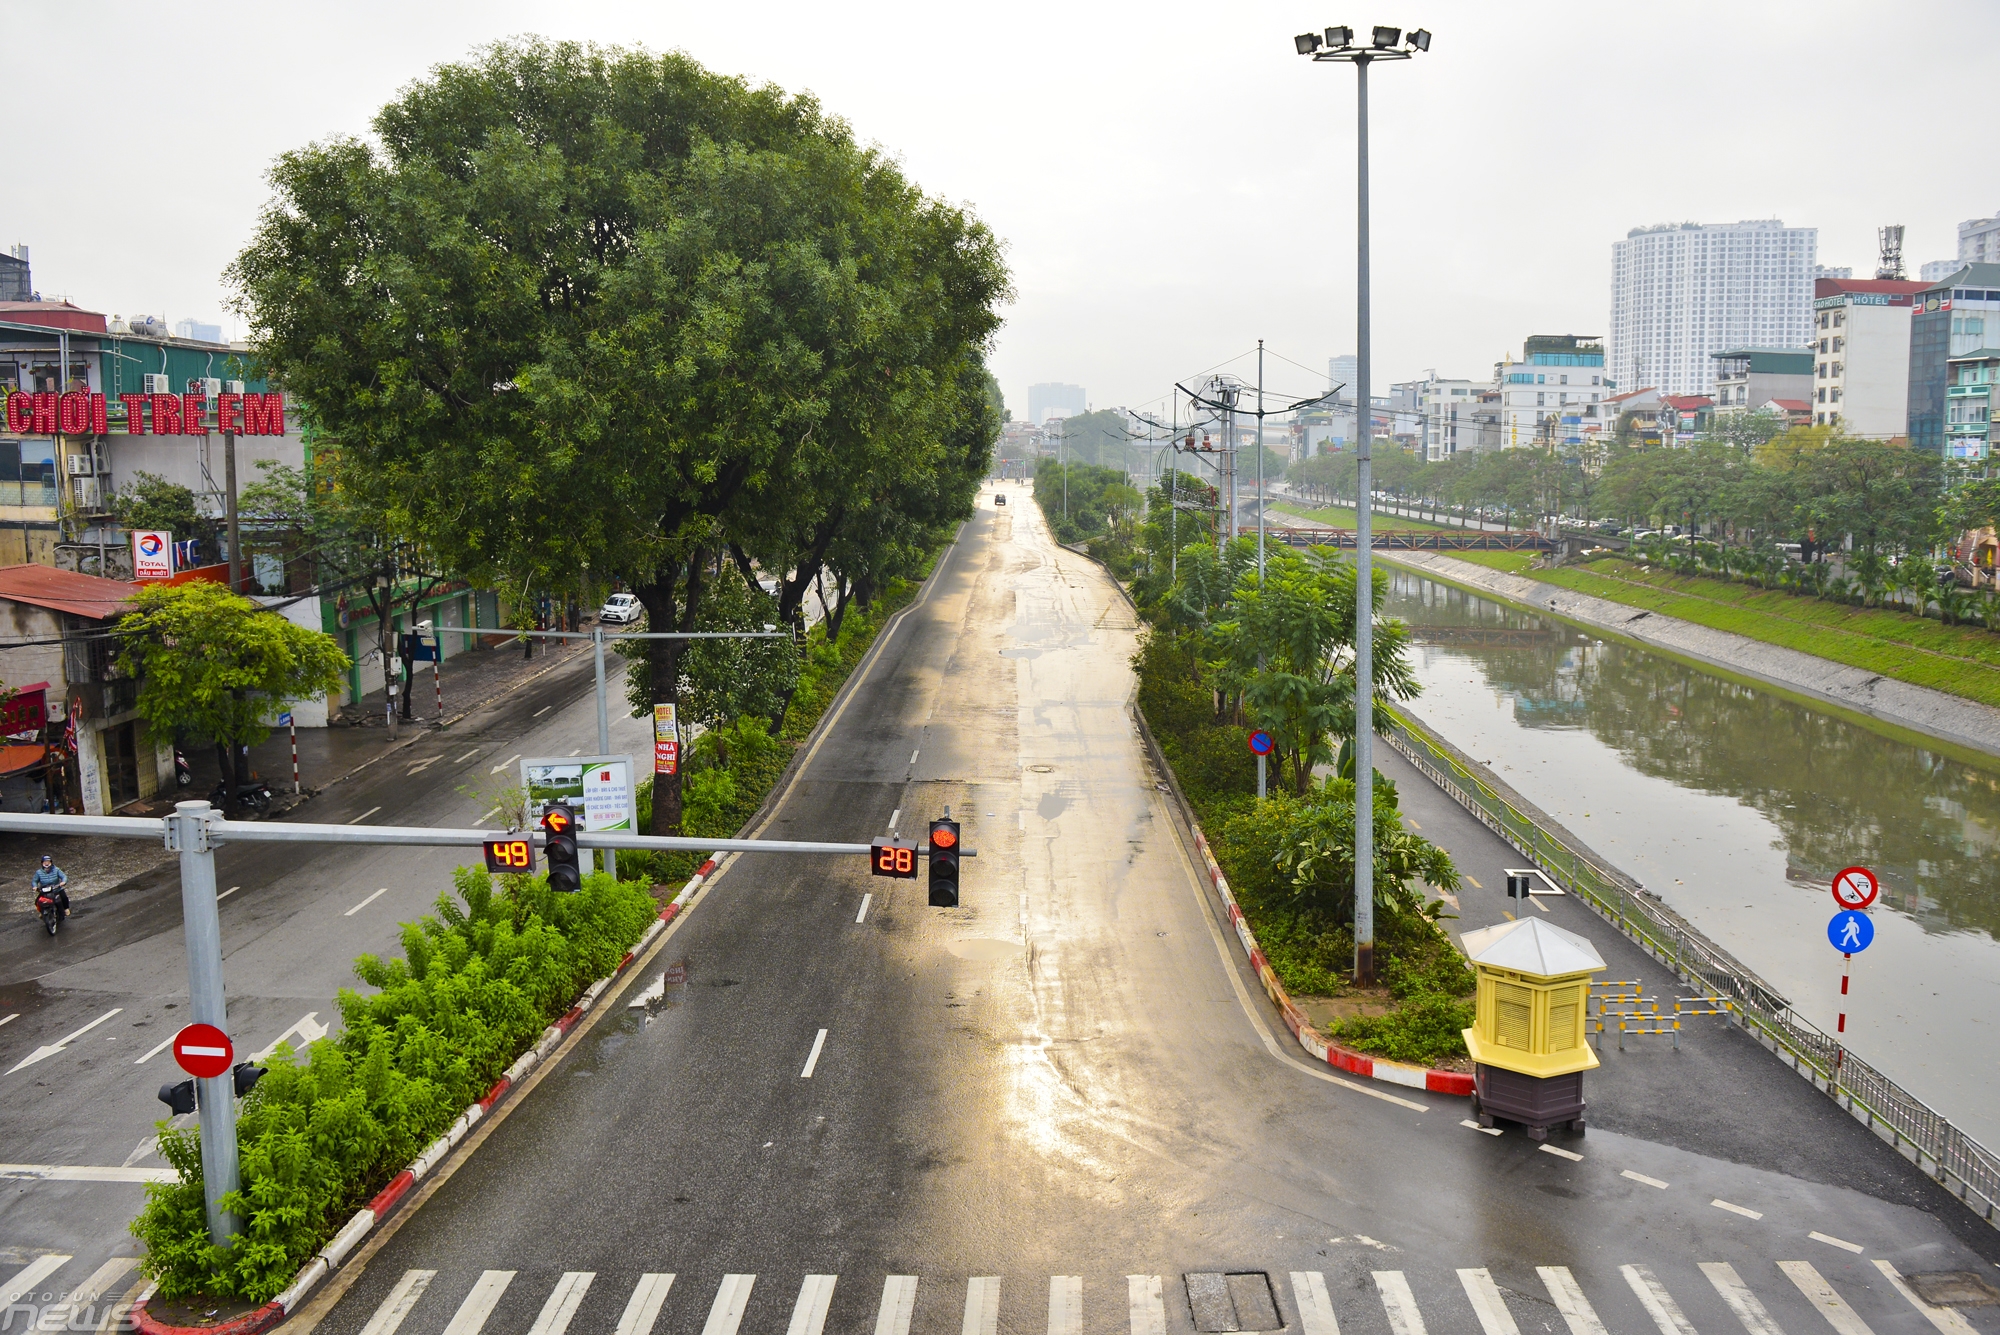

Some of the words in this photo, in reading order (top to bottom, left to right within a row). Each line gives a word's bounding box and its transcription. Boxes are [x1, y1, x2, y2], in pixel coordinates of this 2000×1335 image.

[1825, 297, 1845, 307] HOTEL
[1854, 296, 1888, 305] HOTEL
[7, 386, 108, 435] CHƠI
[120, 381, 208, 436] TRẺ
[218, 392, 285, 436] EM
[656, 707, 672, 715] HOTEL
[657, 742, 675, 751] NHÀ
[493, 842, 528, 867] 49
[879, 846, 912, 872] 28
